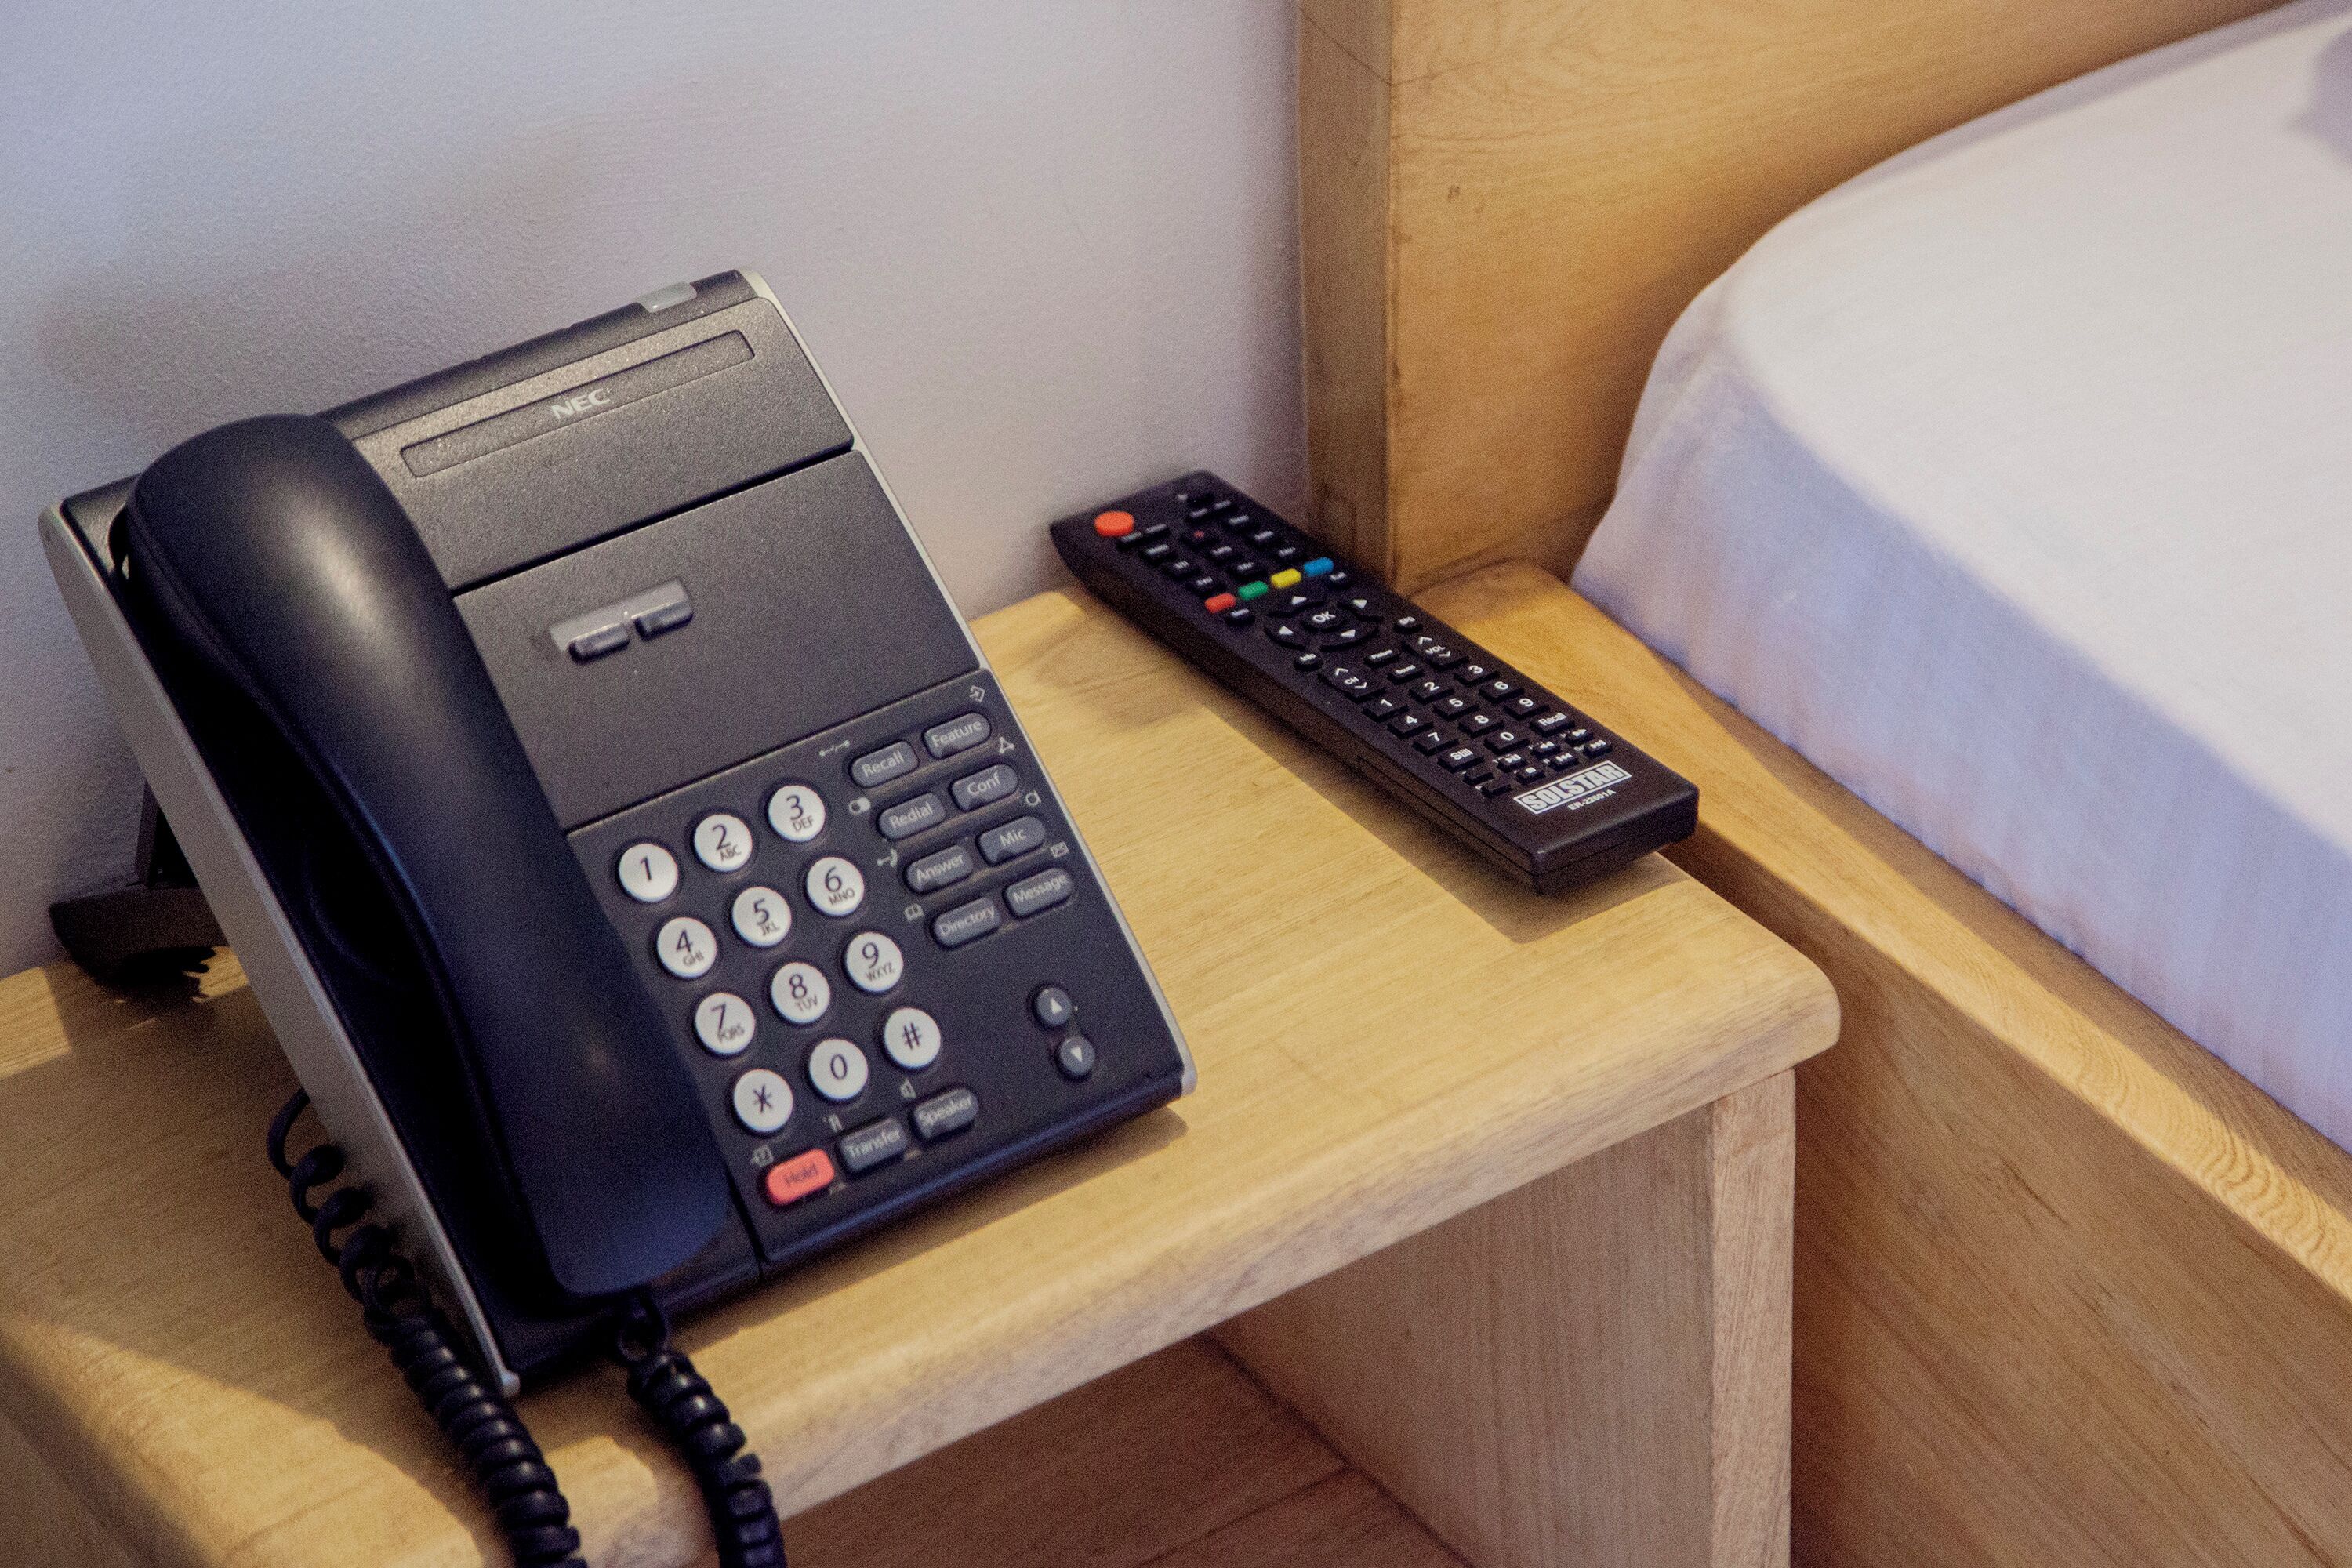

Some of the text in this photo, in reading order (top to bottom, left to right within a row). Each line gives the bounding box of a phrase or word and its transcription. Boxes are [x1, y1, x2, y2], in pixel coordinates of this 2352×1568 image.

[551, 388, 611, 419] NEC
[1312, 610, 1336, 624] OK
[1299, 652, 1316, 662] Info
[1425, 644, 1446, 655] VOL
[1468, 665, 1483, 675] 3
[1344, 676, 1359, 685] CH
[1424, 681, 1440, 692] 2
[1494, 681, 1509, 691] 6
[1380, 699, 1393, 707] 1
[1449, 698, 1464, 708] 5
[1518, 698, 1534, 708] 9
[1406, 715, 1418, 725] 4
[1474, 715, 1490, 724] 8
[1538, 712, 1567, 727] Recall
[931, 721, 982, 747] Feature
[1427, 731, 1441, 742] 7
[1499, 731, 1515, 742] 0
[862, 750, 905, 777] Recall
[1450, 747, 1474, 761] Still
[967, 771, 1001, 796] Conf
[1520, 763, 1627, 811] SOLSTAR
[786, 794, 804, 821] 3
[889, 801, 934, 829] Redial
[792, 815, 814, 832] DEF
[712, 824, 732, 851] 2
[998, 827, 1028, 847] Mic
[719, 844, 742, 862] ABC
[640, 855, 652, 881] 1
[916, 854, 964, 883] Answer
[824, 866, 842, 893] 6
[1011, 874, 1067, 904] Message
[828, 887, 855, 906] MNO
[753, 898, 770, 925] 5
[939, 905, 996, 936] Directory
[760, 923, 780, 937] JKL
[676, 928, 692, 953] 4
[682, 949, 704, 967] GHI
[862, 942, 879, 968] 9
[864, 962, 895, 982] WXYZ
[789, 973, 808, 1000] 8
[794, 995, 818, 1012] TUV
[711, 1003, 727, 1033] 7
[902, 1022, 923, 1050] #
[830, 1054, 848, 1080] 0
[918, 1096, 973, 1126] Speaker
[848, 1127, 902, 1159] Transfer
[784, 1163, 819, 1187] Hold
